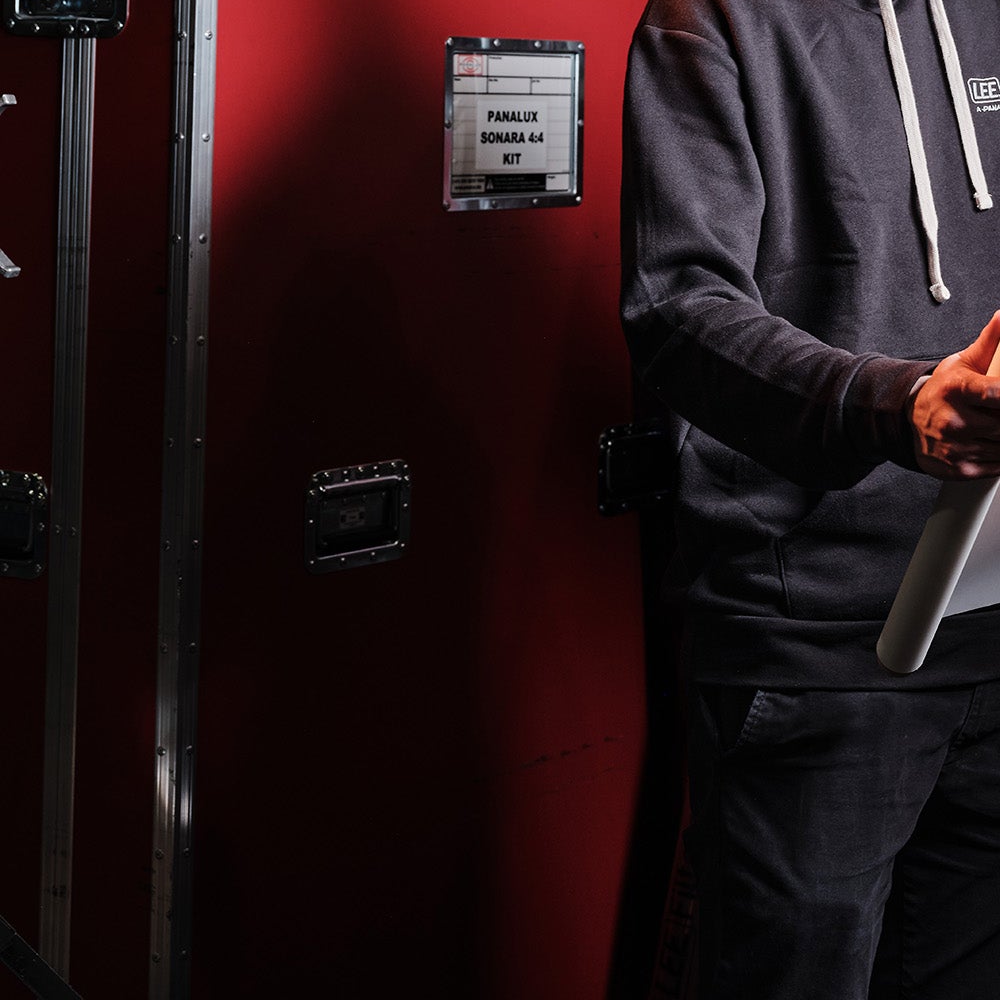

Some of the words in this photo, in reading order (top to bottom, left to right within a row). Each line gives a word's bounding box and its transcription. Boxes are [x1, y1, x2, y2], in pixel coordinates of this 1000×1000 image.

[972, 81, 1000, 100] LEE
[487, 110, 538, 123] PANALUX
[480, 131, 526, 144] SONARA
[527, 131, 544, 144] 4:4
[502, 152, 522, 165] KIT
